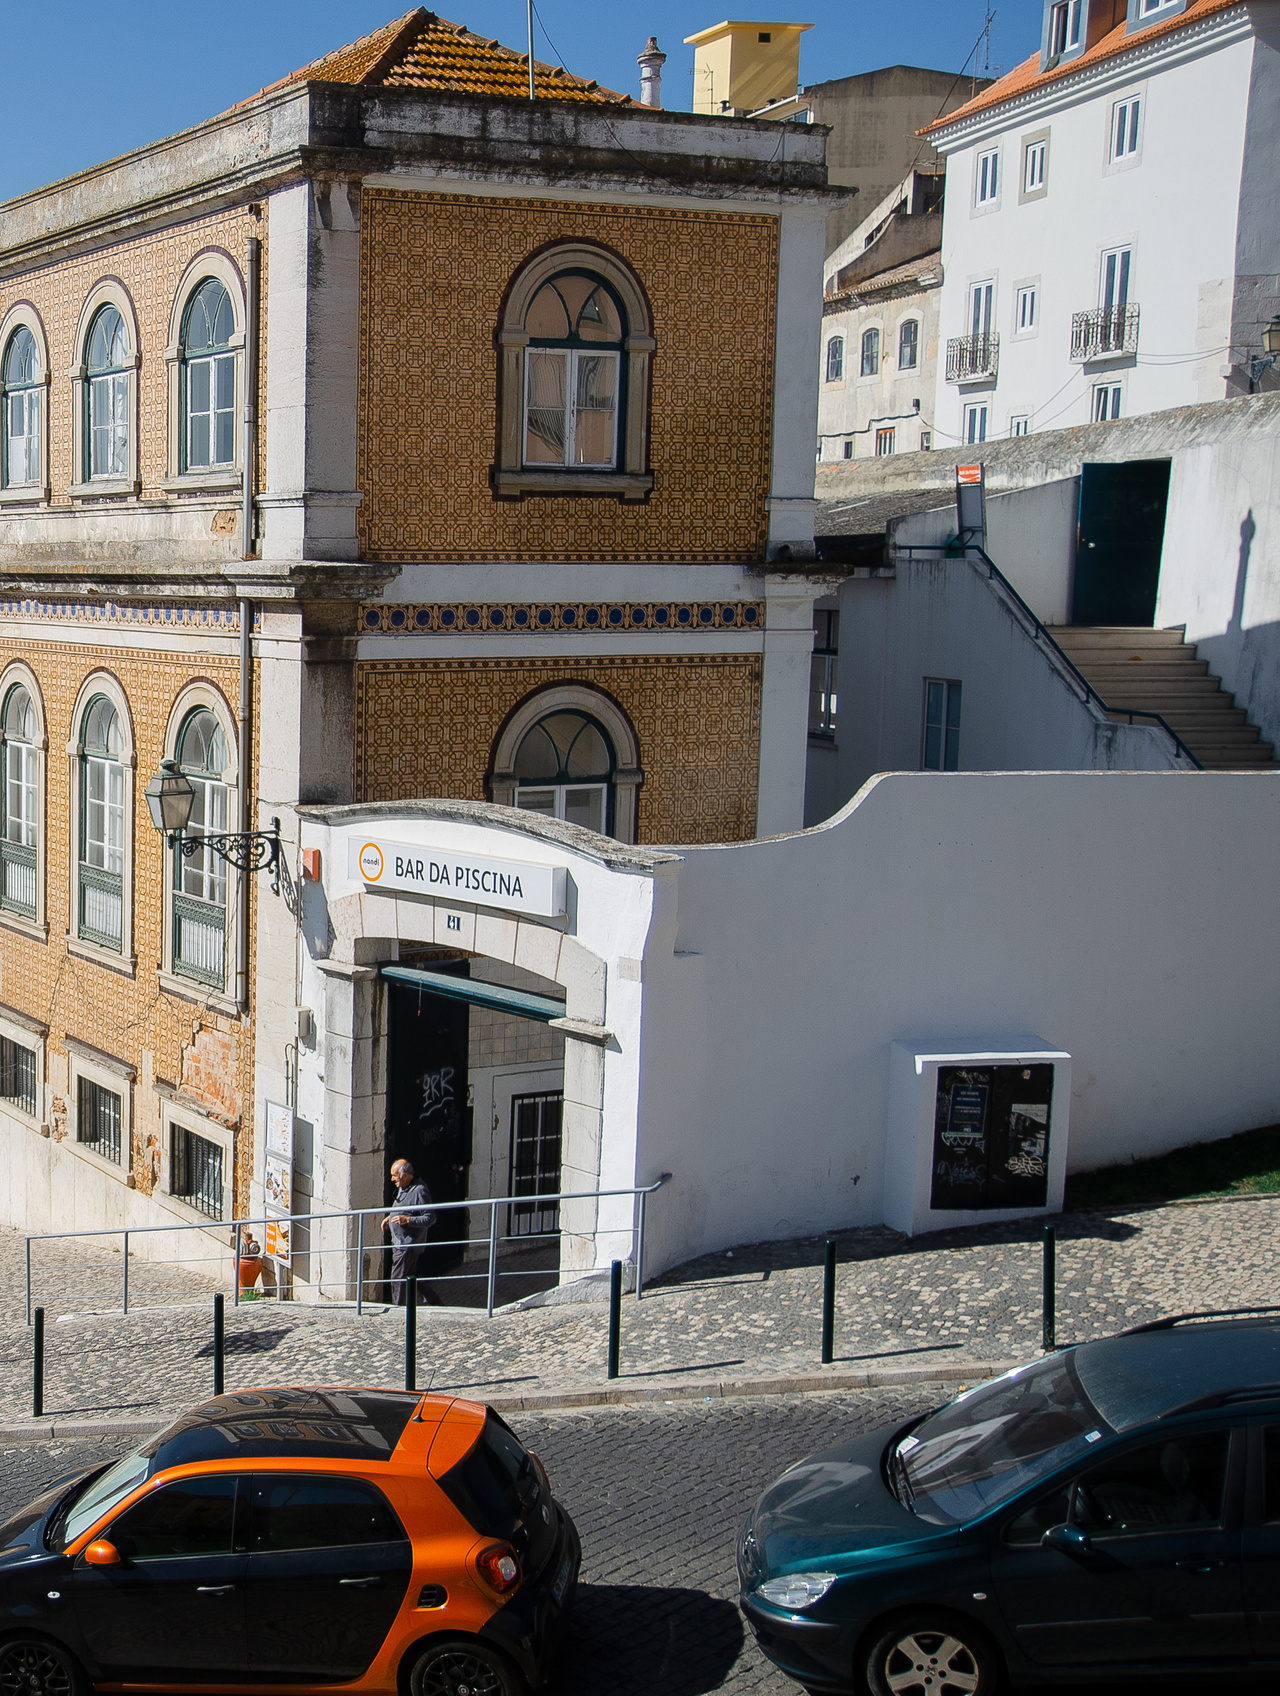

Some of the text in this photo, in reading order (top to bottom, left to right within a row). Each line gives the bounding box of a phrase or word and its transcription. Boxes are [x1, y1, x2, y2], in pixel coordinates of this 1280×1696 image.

[395, 856, 524, 899] BAR DA PISCINA
